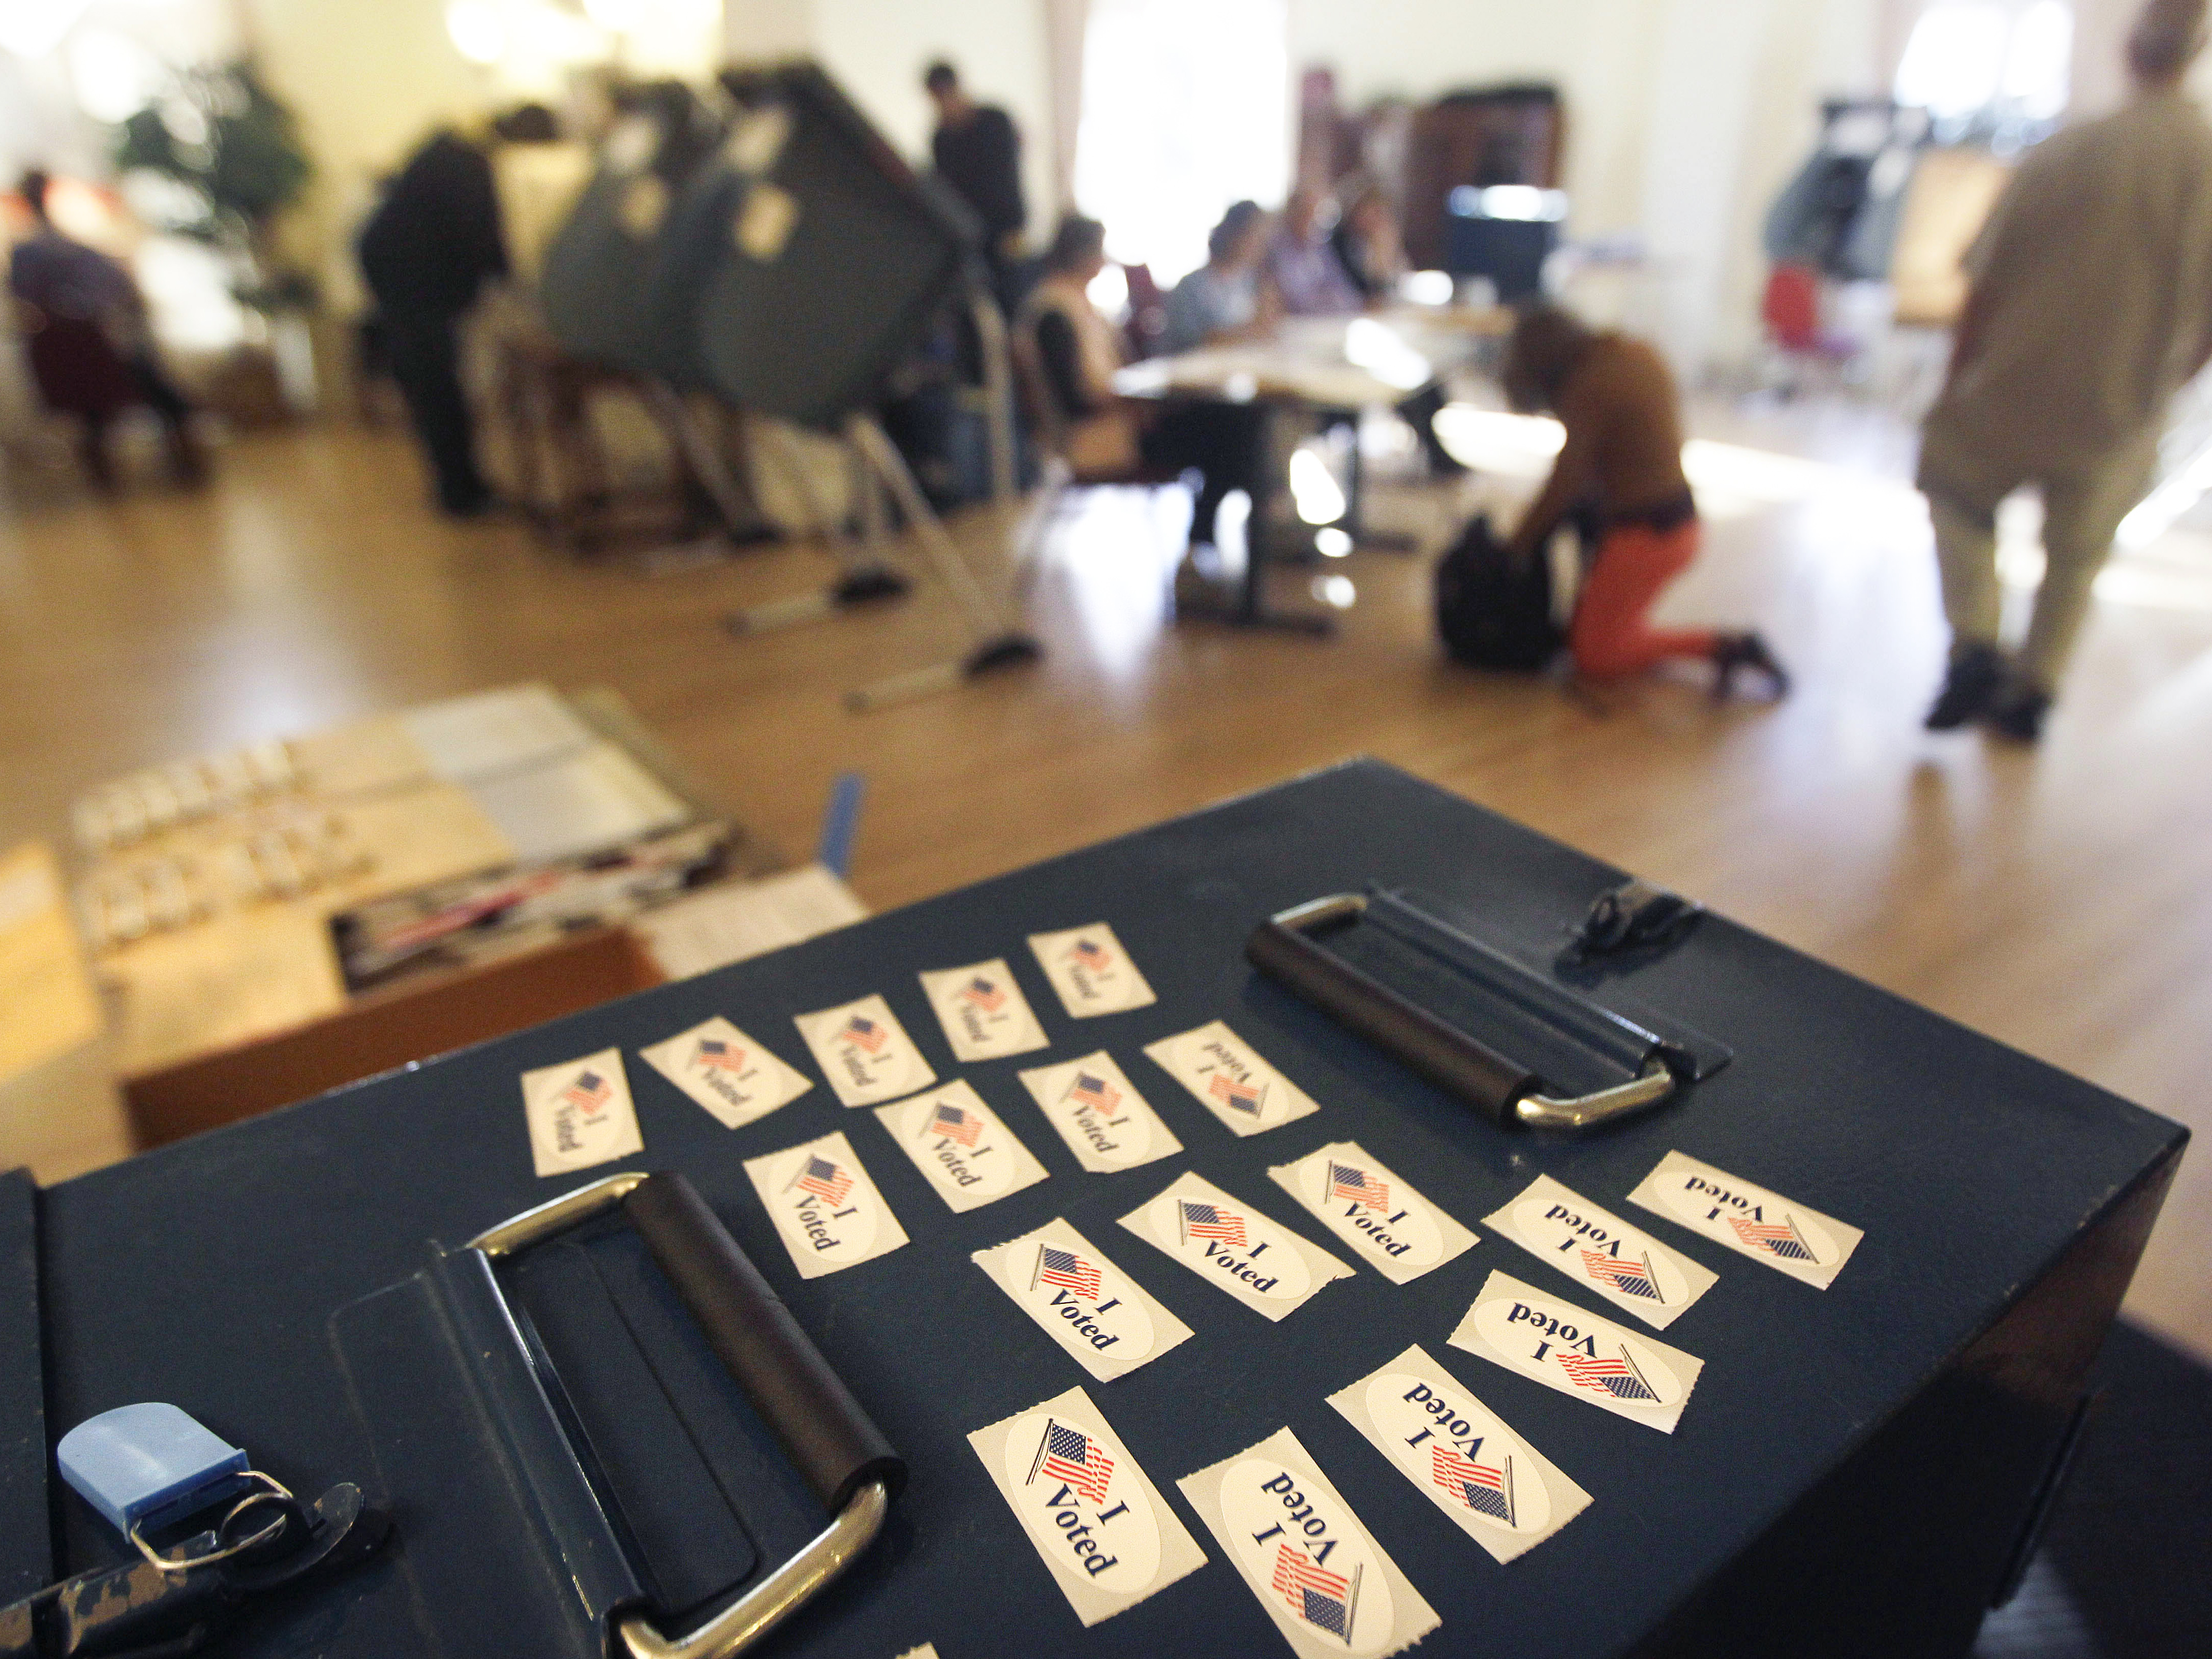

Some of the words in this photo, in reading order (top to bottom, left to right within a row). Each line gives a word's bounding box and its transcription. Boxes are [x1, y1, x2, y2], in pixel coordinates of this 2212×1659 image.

[1073, 1105, 1119, 1153] Voted
[1108, 1115, 1130, 1127] I
[933, 1138, 982, 1187] Voted
[970, 1145, 993, 1158] I
[834, 1206, 857, 1219] I
[1388, 1210, 1410, 1224] I
[1683, 1177, 1763, 1223] Voted
[1706, 1207, 1722, 1221] I
[795, 1195, 841, 1251] Voted
[1343, 1201, 1412, 1257] Voted
[1544, 1205, 1621, 1258] Voted
[1247, 1241, 1271, 1259] I
[1558, 1237, 1578, 1252] I
[1205, 1240, 1279, 1293] Voted
[1050, 1288, 1120, 1351] Voted
[1094, 1297, 1123, 1315] I
[1506, 1303, 1599, 1359] Voted
[1530, 1340, 1554, 1362] I
[1402, 1382, 1486, 1463] Voted
[1404, 1426, 1435, 1450] I
[1095, 1499, 1130, 1525] I
[1262, 1472, 1338, 1565] Voted
[1044, 1484, 1118, 1578] Voted
[1252, 1521, 1287, 1548] I
